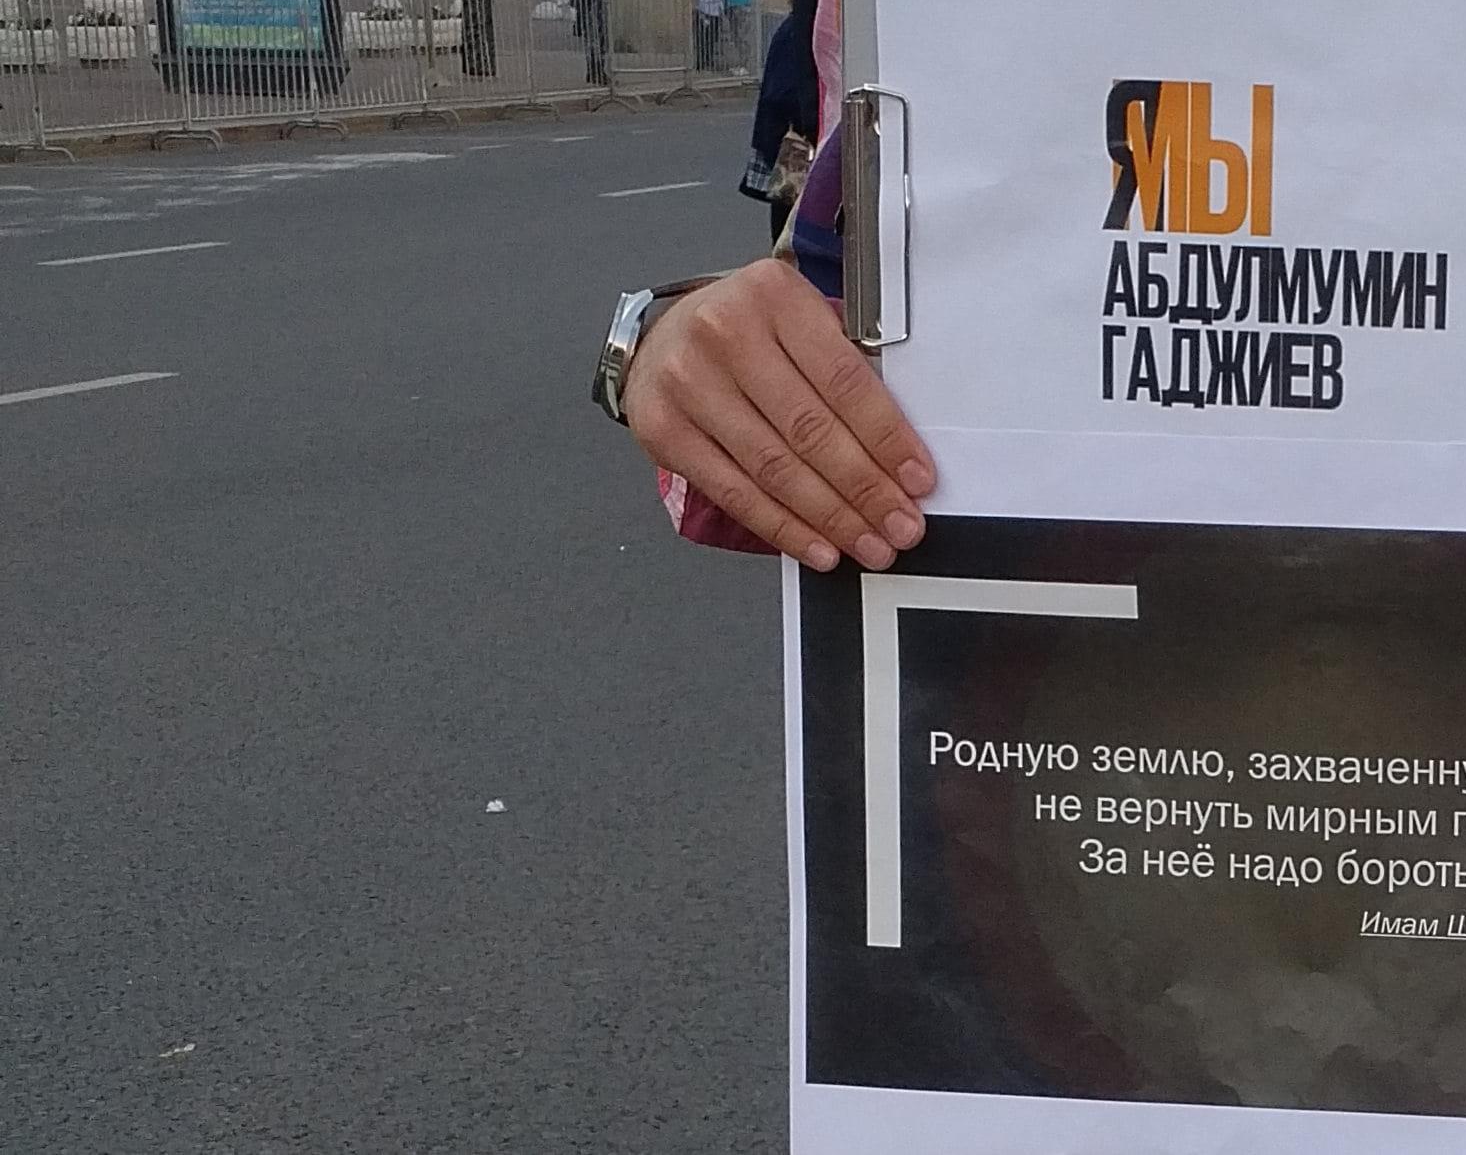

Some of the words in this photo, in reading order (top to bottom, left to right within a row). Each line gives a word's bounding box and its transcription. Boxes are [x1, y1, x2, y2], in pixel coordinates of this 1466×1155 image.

[1101, 239, 1449, 331] АБДУЛМУМИН
[1101, 324, 1344, 410] ГАДЖИЕВ
[928, 731, 1080, 777] Родную
[1091, 744, 1235, 783] землю,
[1034, 792, 1082, 822] не
[1096, 795, 1254, 835] вернуть
[1266, 803, 1438, 841] мирным
[1078, 838, 1128, 875] За
[1142, 842, 1216, 877] неё
[1228, 851, 1323, 887] надо
[1360, 910, 1439, 937] Имам
